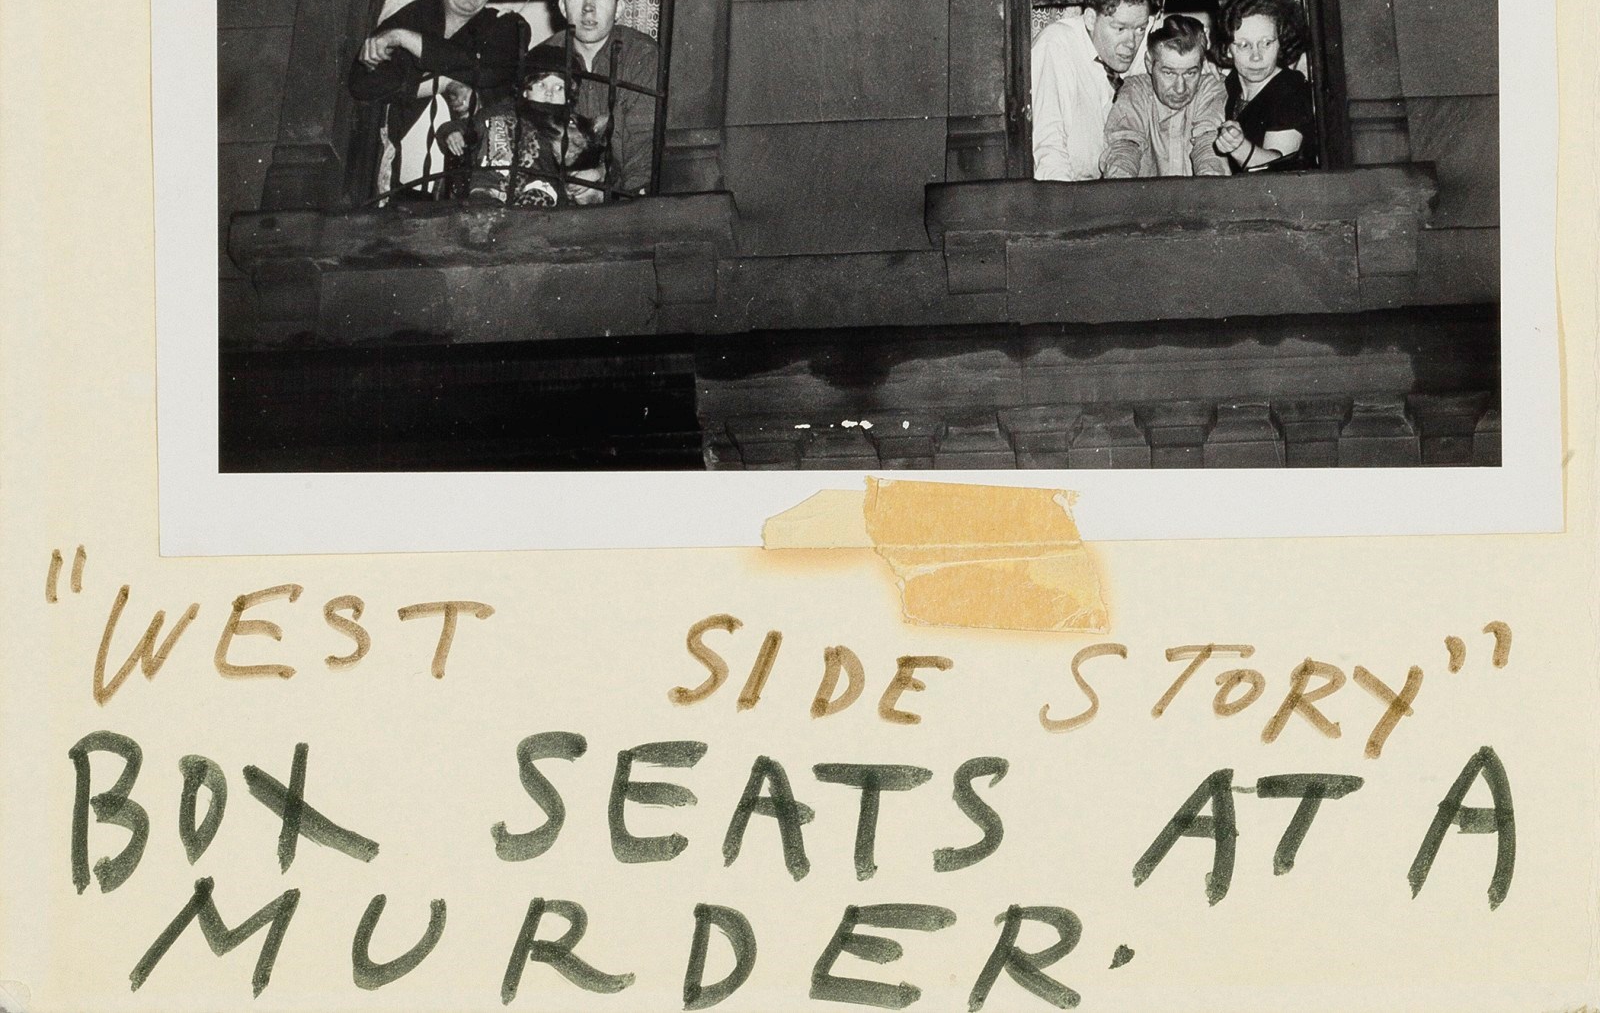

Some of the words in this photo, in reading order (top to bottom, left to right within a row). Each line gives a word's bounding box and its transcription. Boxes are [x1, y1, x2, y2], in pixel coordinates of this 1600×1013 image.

[668, 614, 955, 725] SIDE
[68, 730, 379, 896] BOX
[491, 730, 1009, 882] SEATS
[1132, 768, 1365, 907] AT
[1407, 746, 1516, 911] A
[131, 876, 1136, 1012] MURDER.
